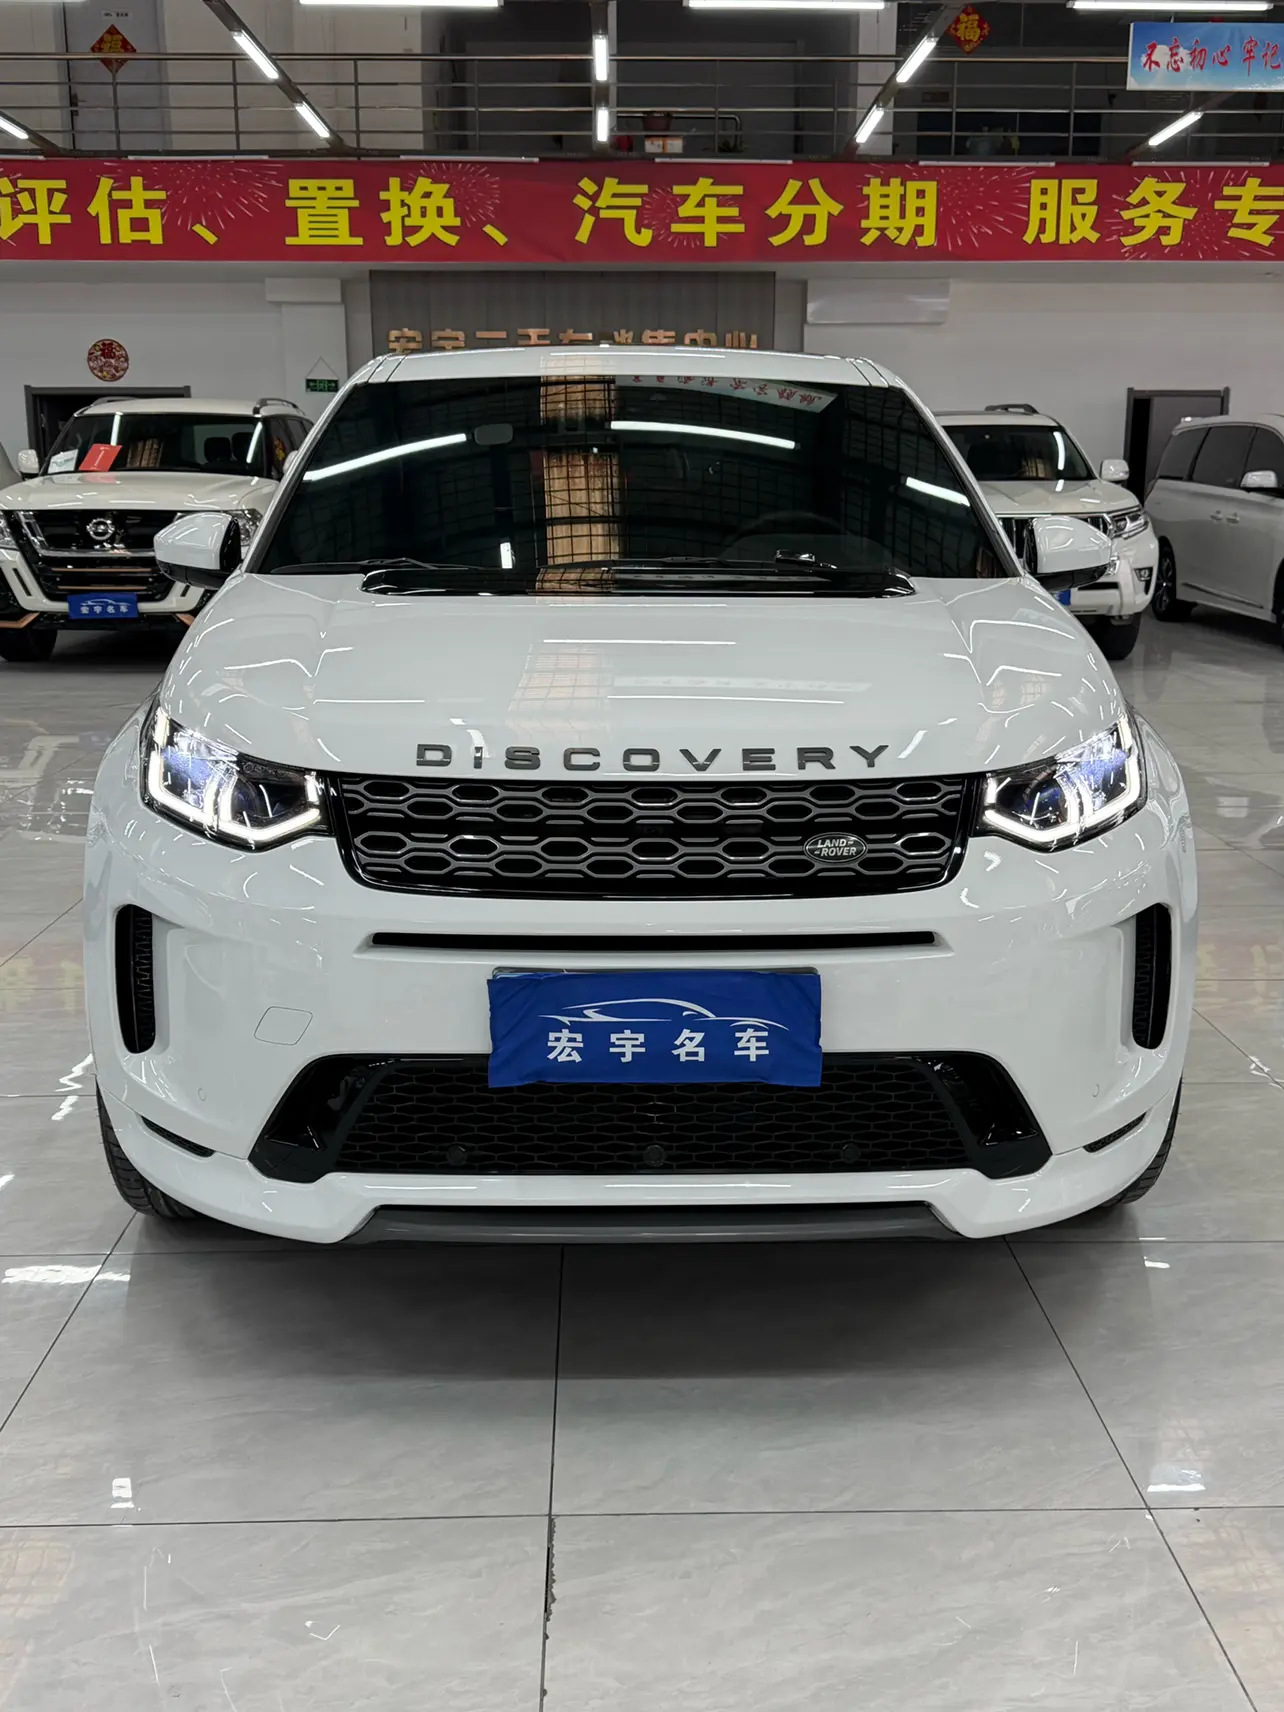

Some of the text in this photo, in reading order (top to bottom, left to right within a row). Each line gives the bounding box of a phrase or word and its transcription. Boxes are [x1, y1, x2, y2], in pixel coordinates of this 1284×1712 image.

[416, 743, 889, 771] DISCOVERY
[817, 839, 847, 848] LAND
[820, 847, 857, 857] ROVER
[547, 1028, 770, 1063] 宏宇名车
